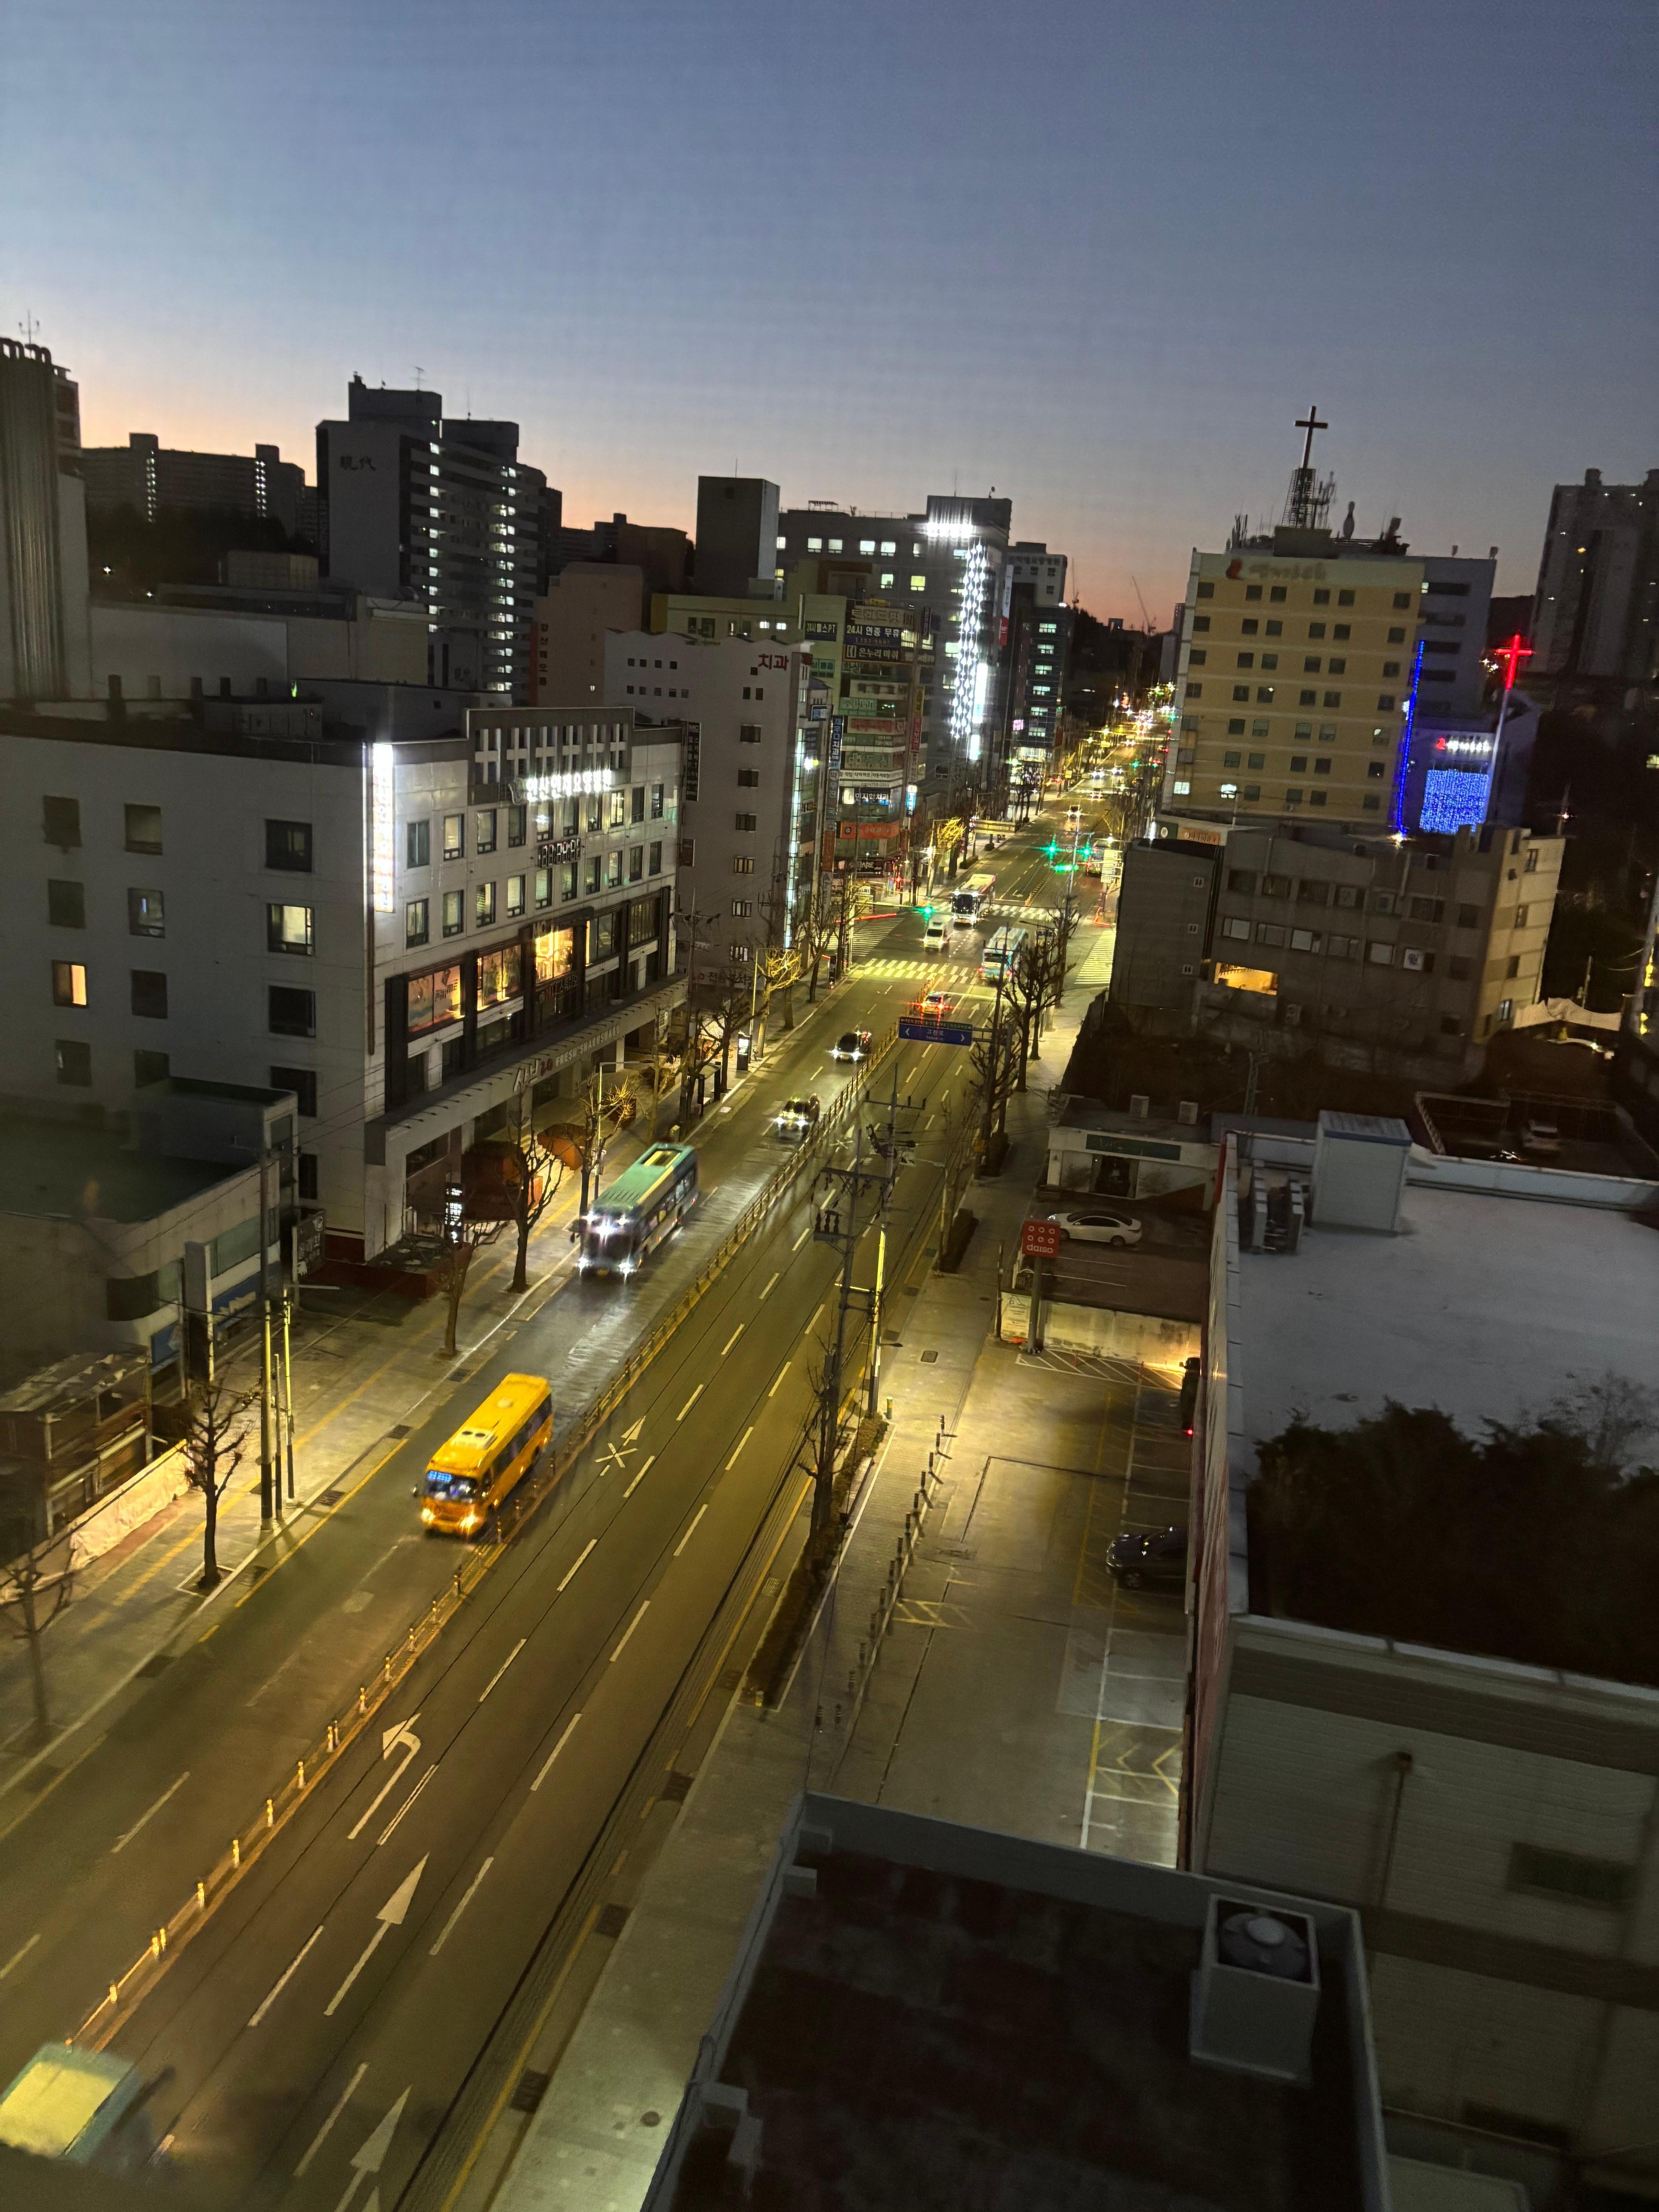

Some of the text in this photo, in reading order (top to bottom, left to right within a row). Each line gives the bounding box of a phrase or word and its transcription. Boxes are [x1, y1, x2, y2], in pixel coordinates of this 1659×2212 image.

[847, 625, 900, 638] 24시 연중 무휴
[757, 653, 789, 671] 치과
[1026, 1243, 1054, 1254] daiso
